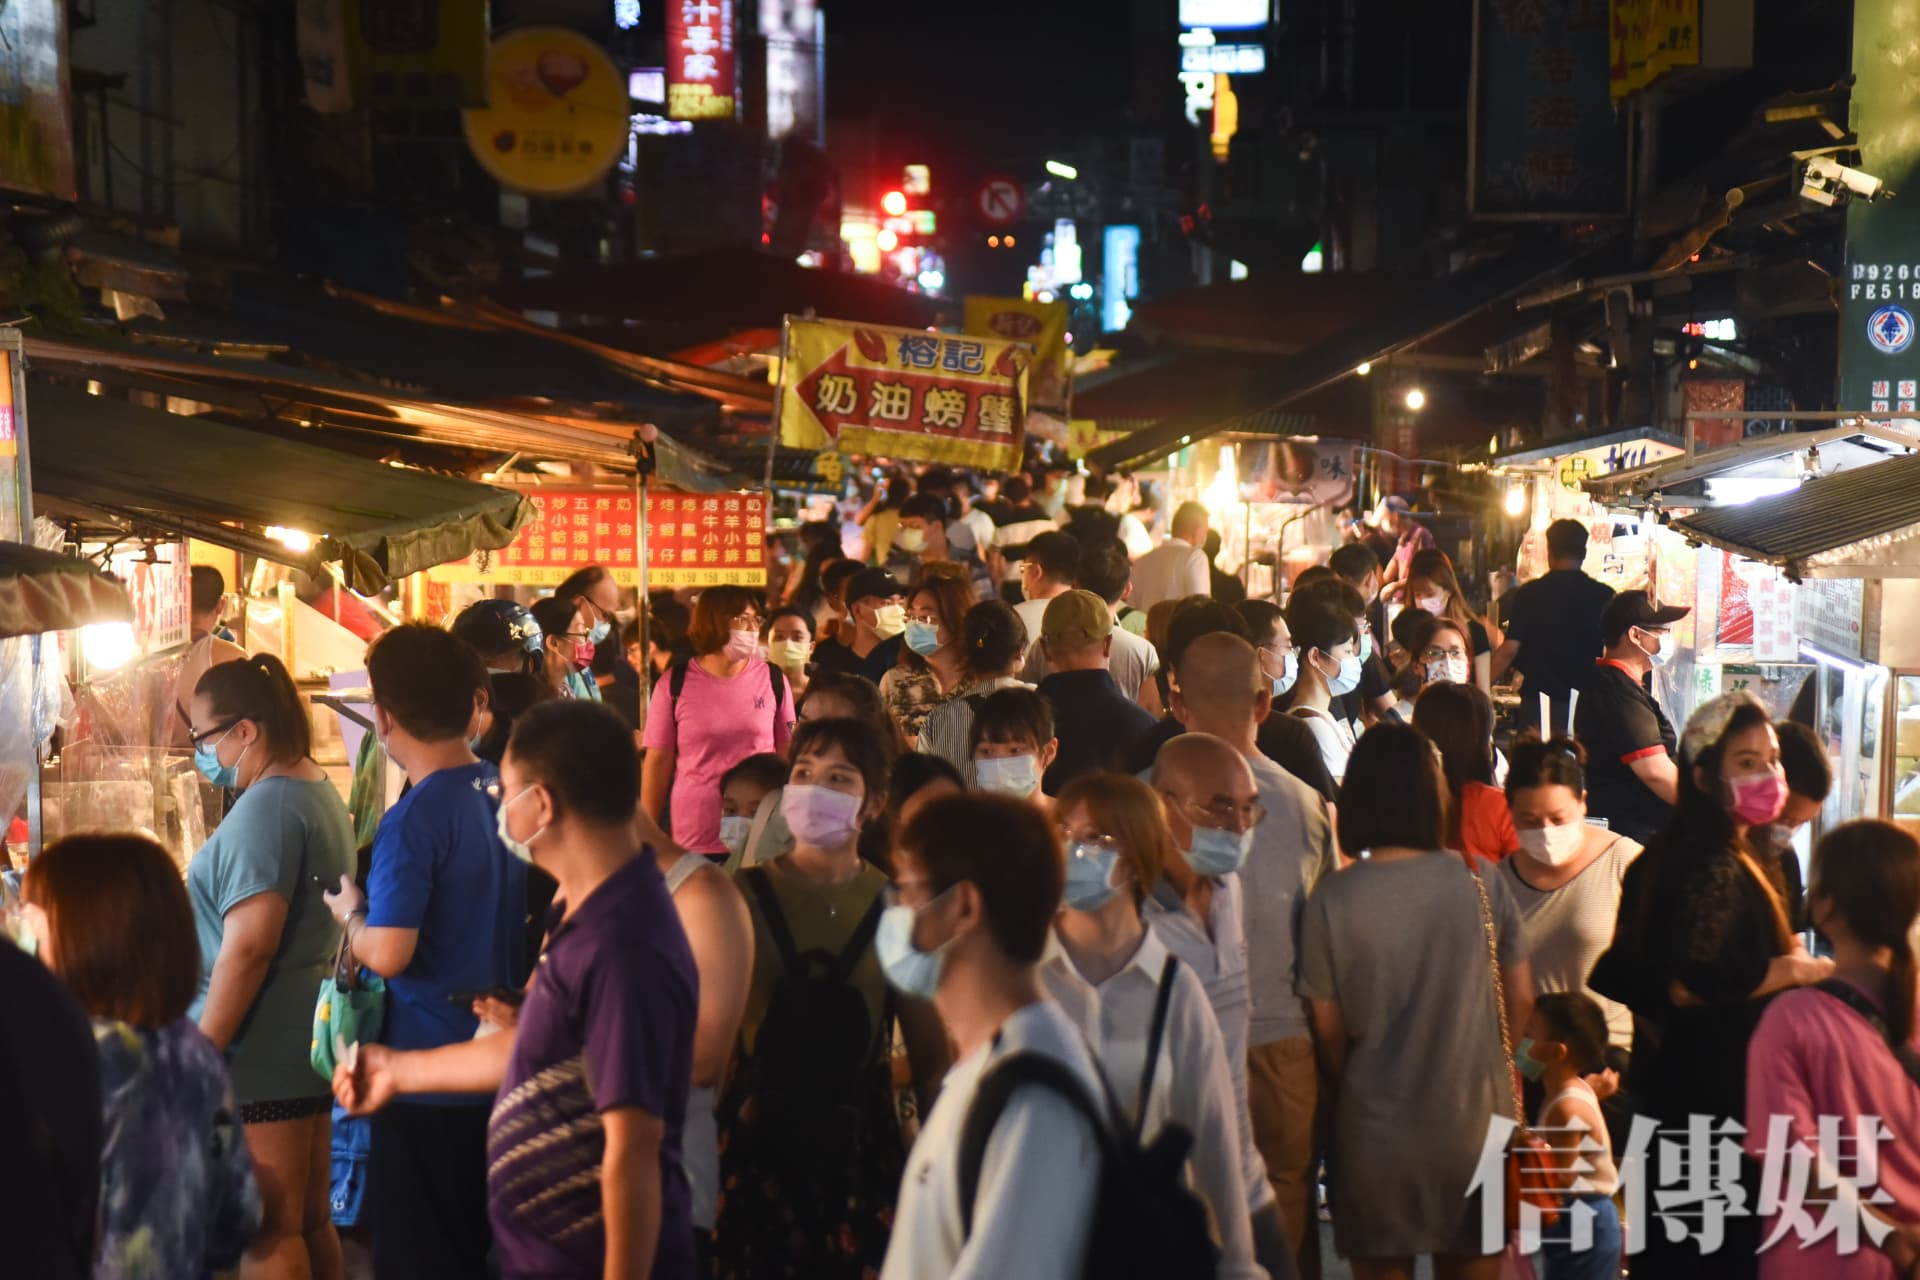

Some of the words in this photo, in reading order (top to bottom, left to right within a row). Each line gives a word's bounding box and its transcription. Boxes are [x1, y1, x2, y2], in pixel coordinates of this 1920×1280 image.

[897, 334, 985, 375] 榕記
[815, 372, 1016, 436] 奶油螃蟹
[702, 498, 719, 562] 烤牛小排
[724, 498, 741, 562] 烤羊小排
[703, 571, 718, 583] 150
[746, 571, 761, 583] 200
[1694, 667, 1713, 704] 綠
